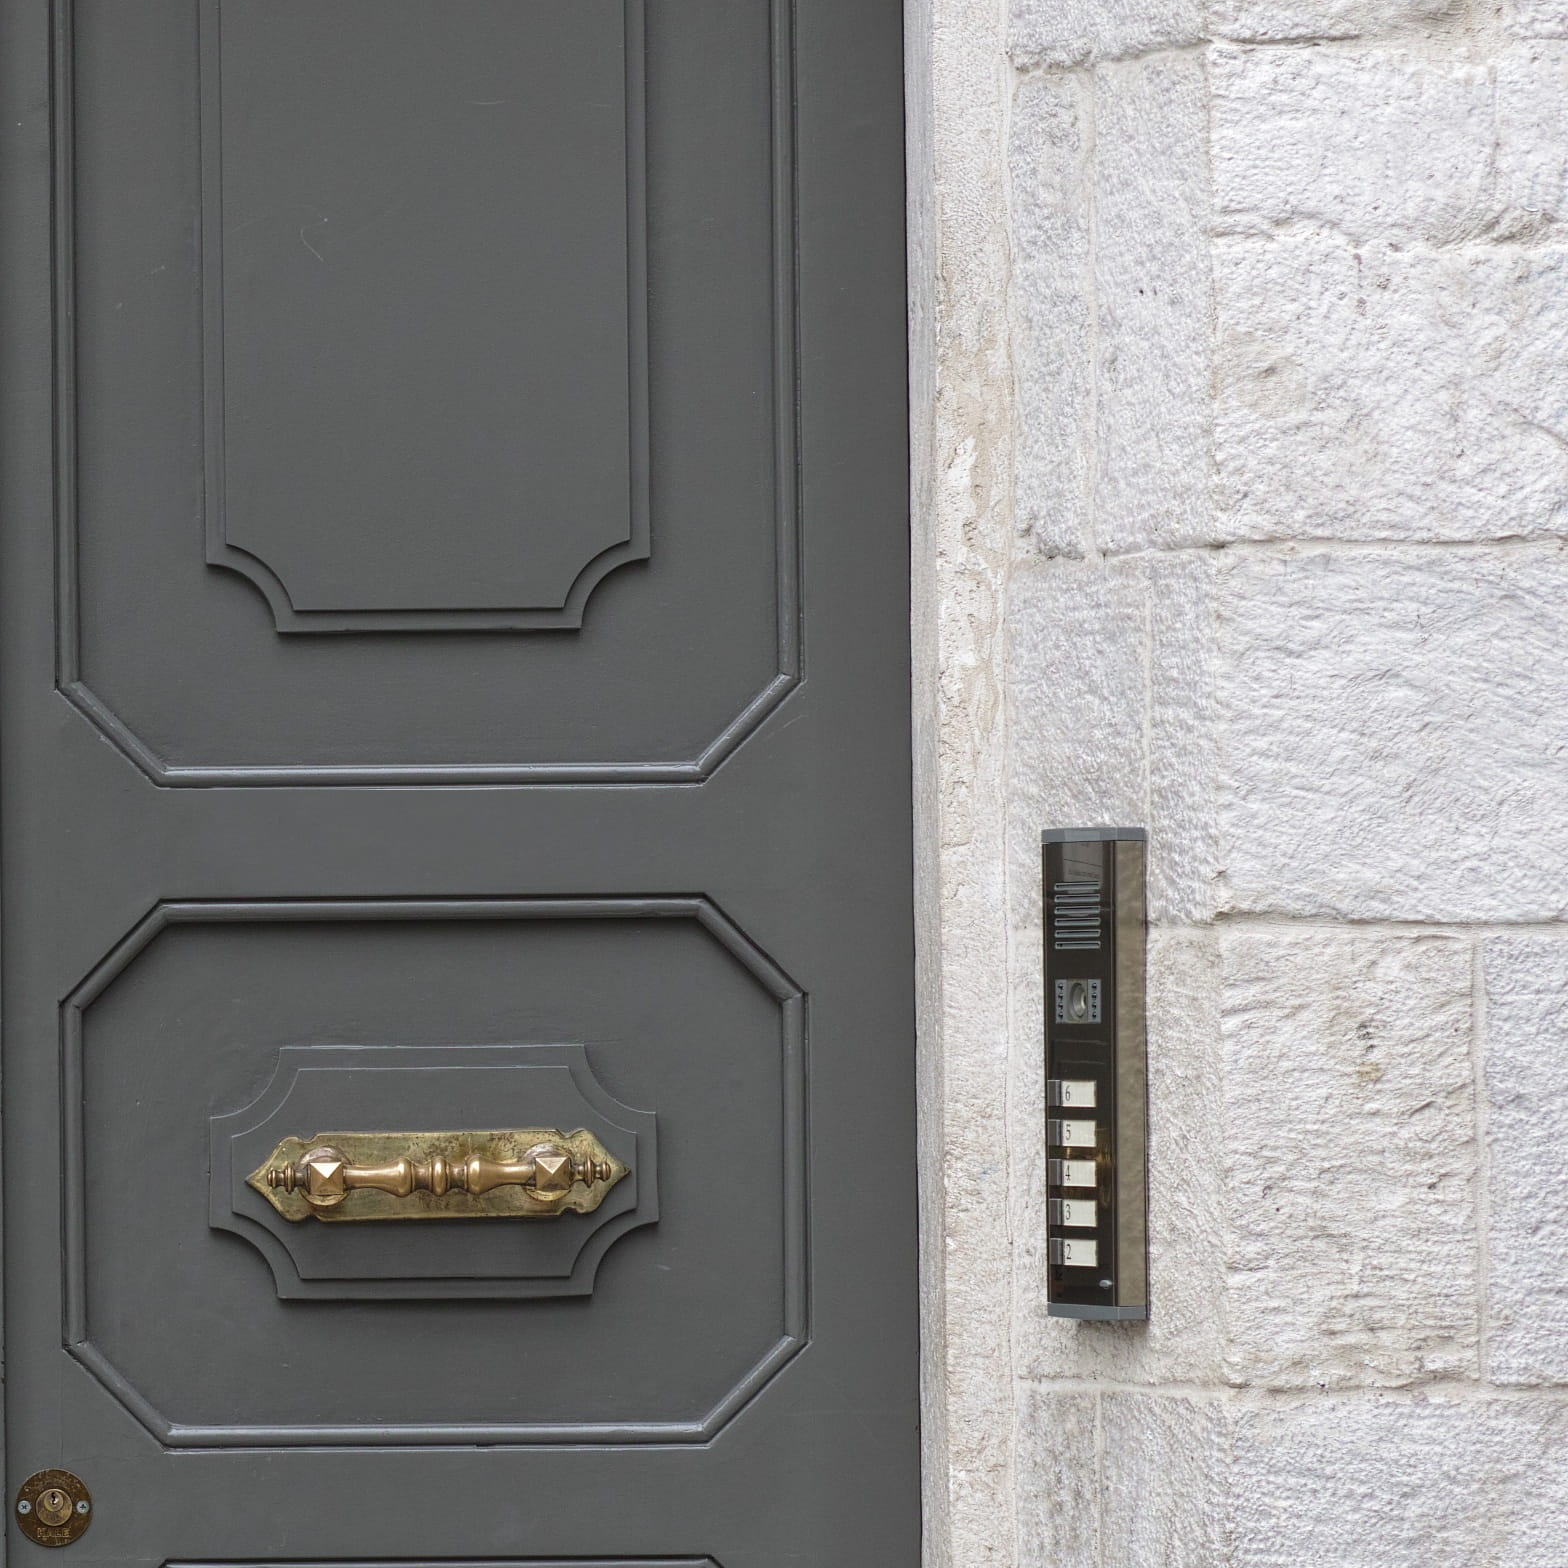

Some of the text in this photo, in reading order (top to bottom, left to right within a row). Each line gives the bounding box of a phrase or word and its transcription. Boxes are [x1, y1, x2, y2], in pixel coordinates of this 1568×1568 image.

[1065, 1085, 1071, 1102] 6
[1065, 1123, 1072, 1141] 5
[1065, 1164, 1071, 1182] 4
[1065, 1203, 1072, 1221] 3
[1066, 1243, 1072, 1260] 2
